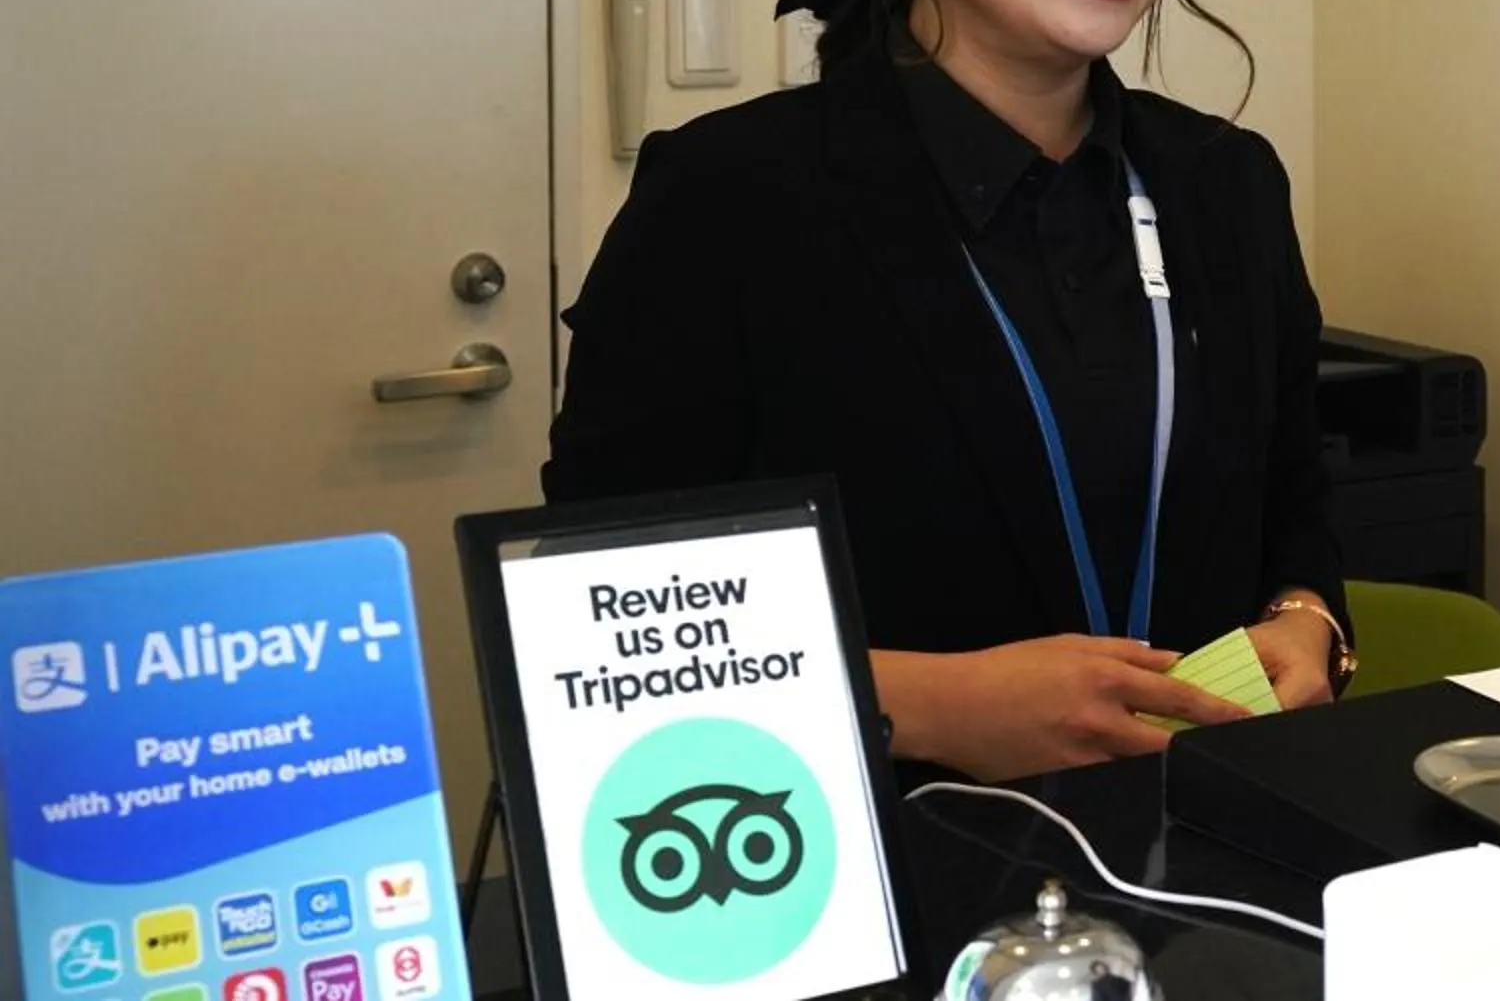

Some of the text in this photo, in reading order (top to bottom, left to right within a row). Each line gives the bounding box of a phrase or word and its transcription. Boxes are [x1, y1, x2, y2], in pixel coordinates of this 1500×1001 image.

[589, 575, 747, 621] Review
[616, 618, 729, 658] us on
[555, 649, 804, 712] Tripadvisor
[136, 714, 312, 767] Pay smart
[42, 744, 405, 822] with your home e-wallets
